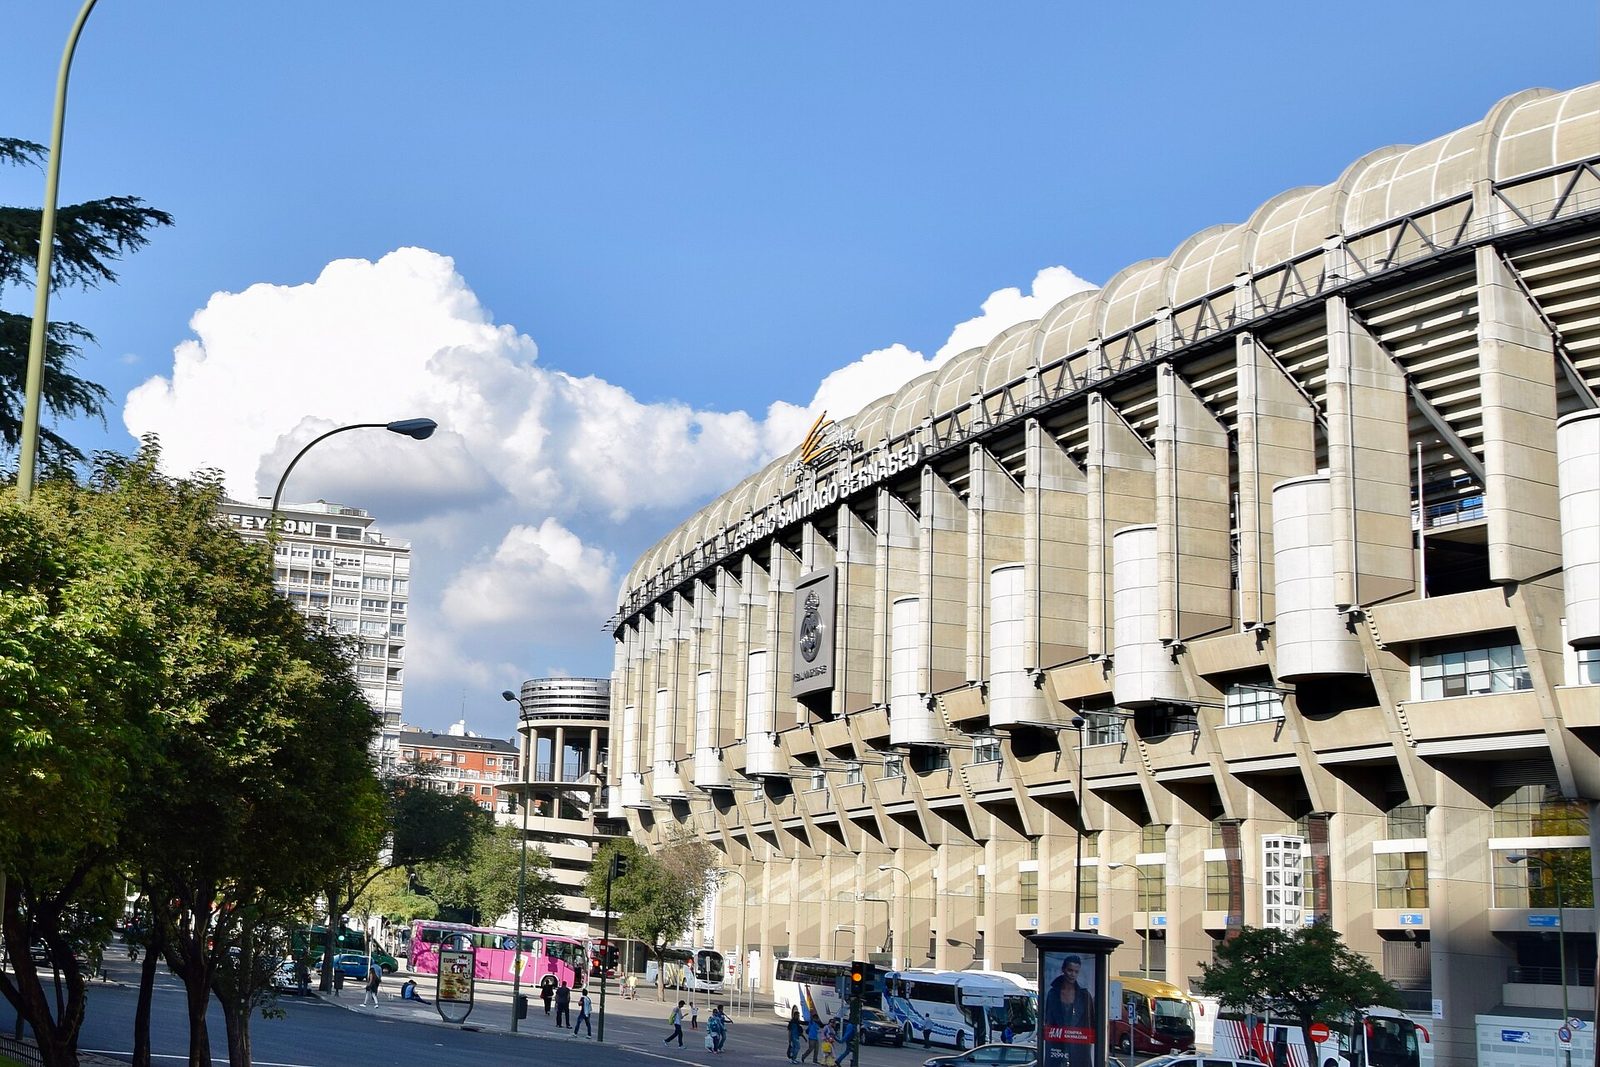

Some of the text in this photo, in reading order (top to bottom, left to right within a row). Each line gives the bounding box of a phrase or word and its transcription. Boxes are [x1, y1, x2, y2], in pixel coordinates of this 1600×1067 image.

[733, 441, 920, 551] ESTADIO SANTIAGO BERNABEU
[1405, 915, 1413, 924] 12
